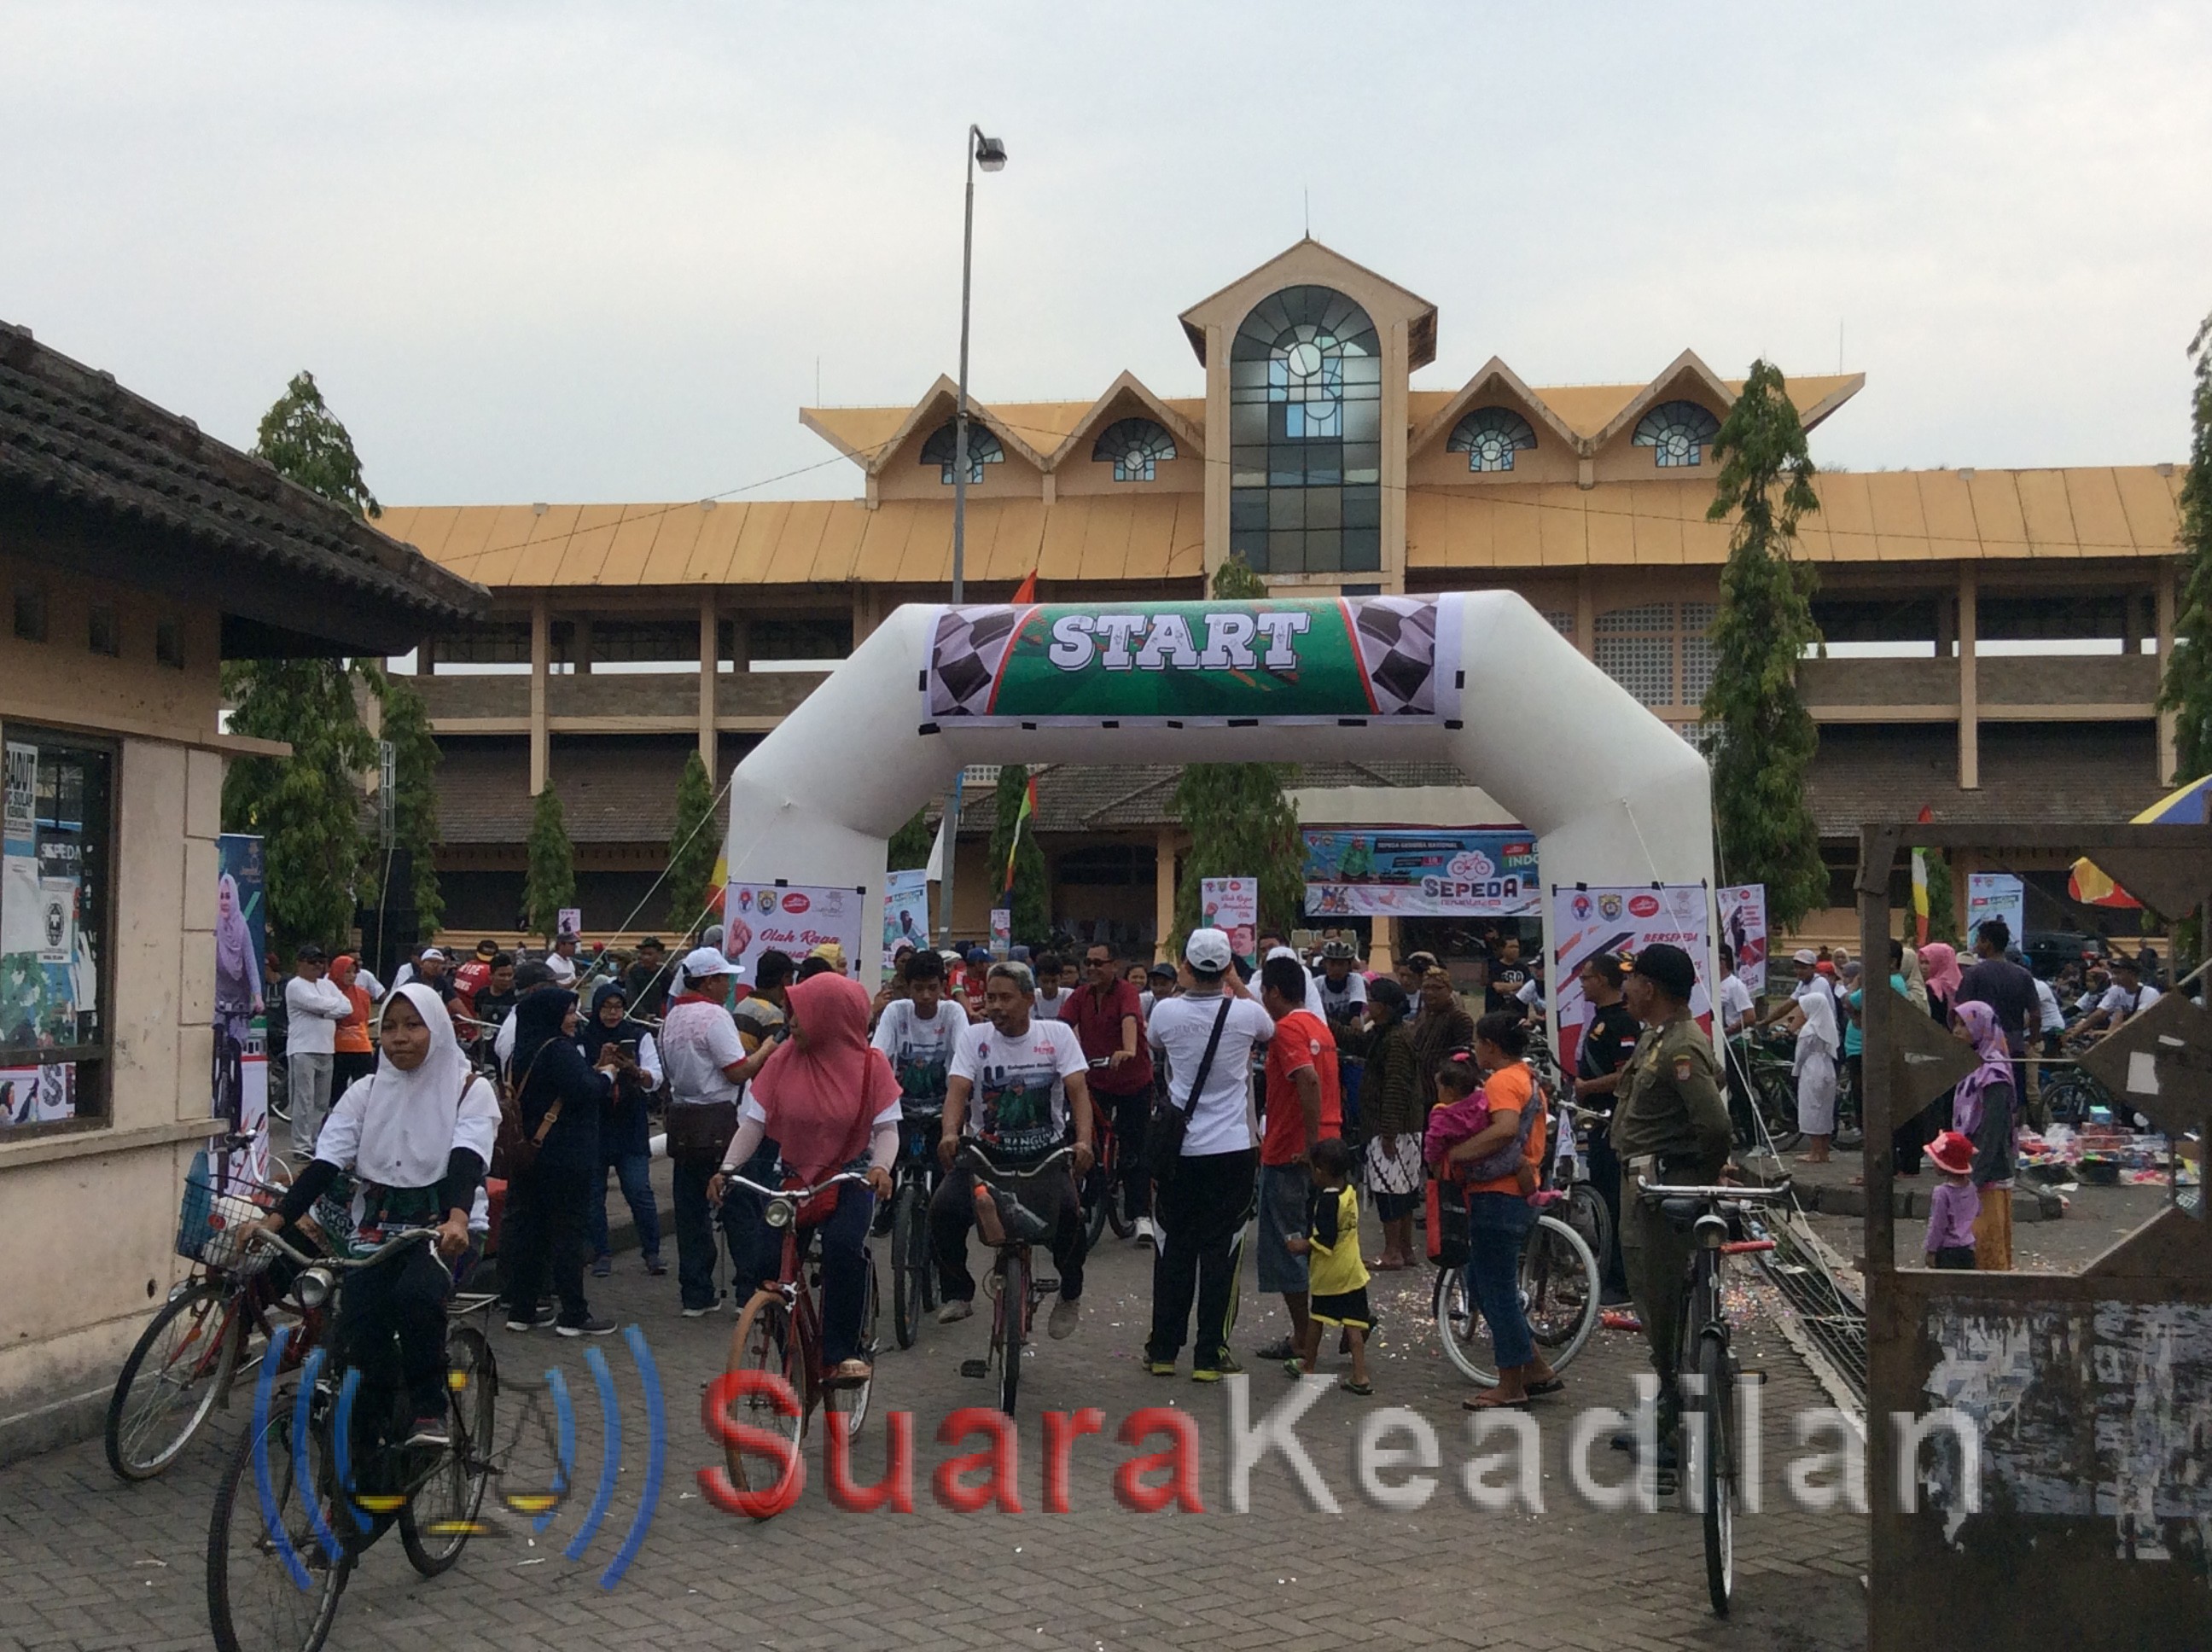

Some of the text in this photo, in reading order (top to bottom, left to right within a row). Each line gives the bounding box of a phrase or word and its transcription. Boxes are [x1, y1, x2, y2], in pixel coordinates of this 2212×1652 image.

[1048, 610, 1311, 672] START
[1423, 878, 1517, 898] SEPEDA
[760, 928, 795, 943] Olah
